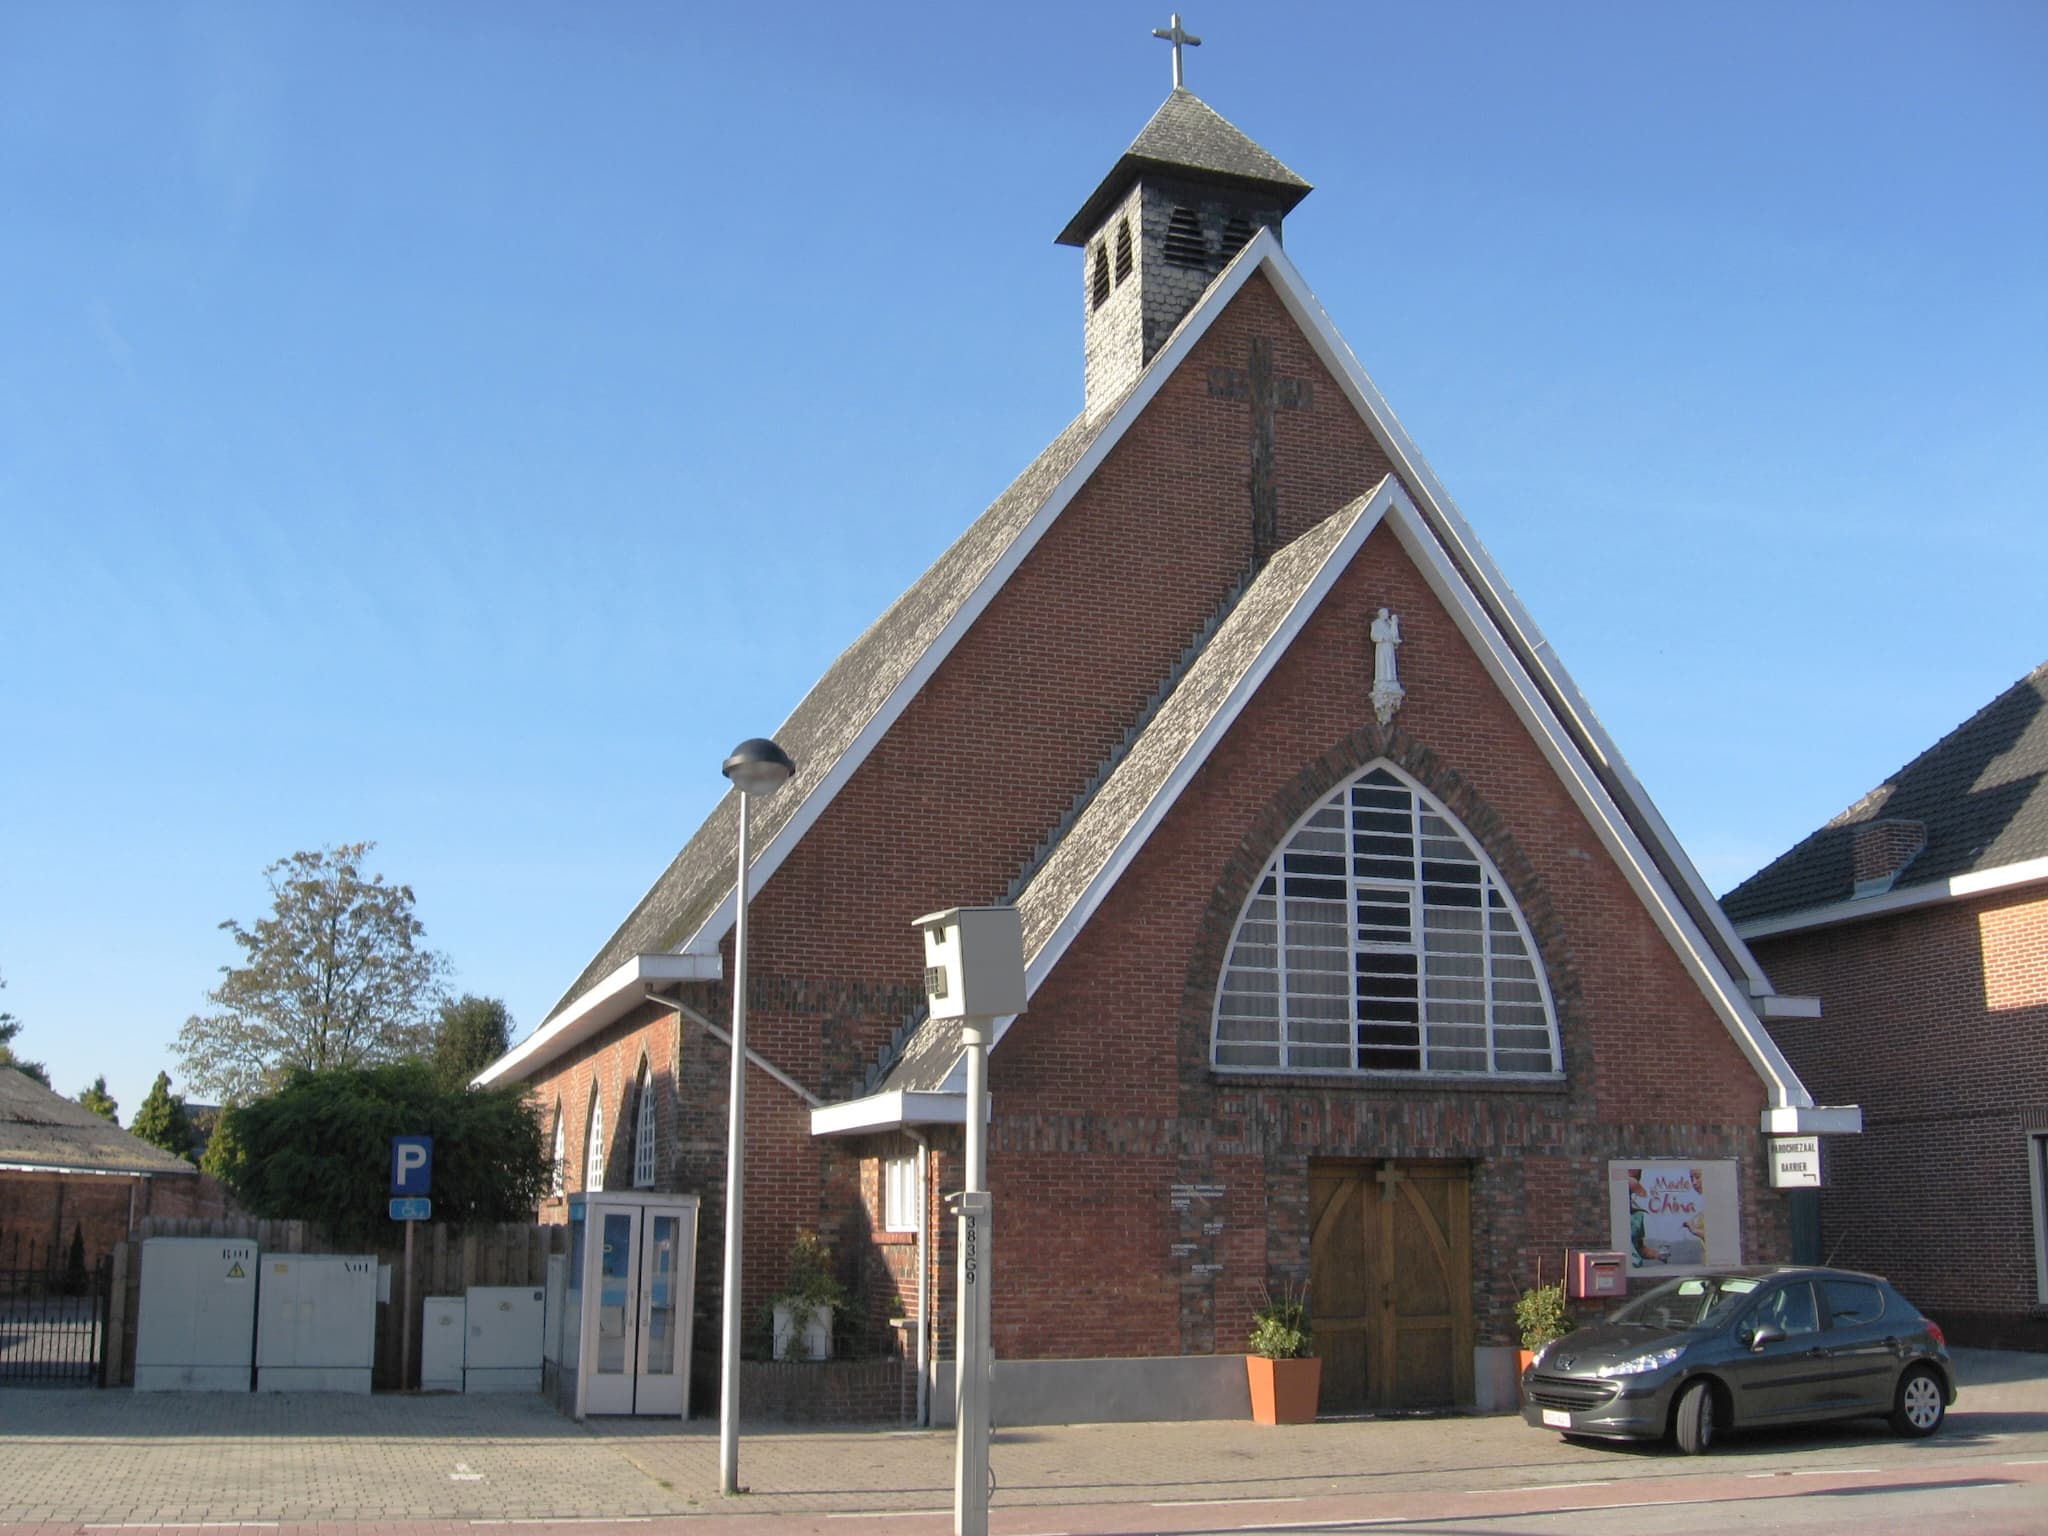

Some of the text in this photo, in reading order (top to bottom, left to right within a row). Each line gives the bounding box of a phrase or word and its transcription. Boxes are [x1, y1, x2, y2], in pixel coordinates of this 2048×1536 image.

[1770, 1142, 1816, 1154] PAROCHIEZAAL
[397, 1143, 427, 1185] P
[1781, 1162, 1807, 1173] BARRIER
[1655, 1175, 1690, 1190] Made
[1648, 1193, 1697, 1214] China
